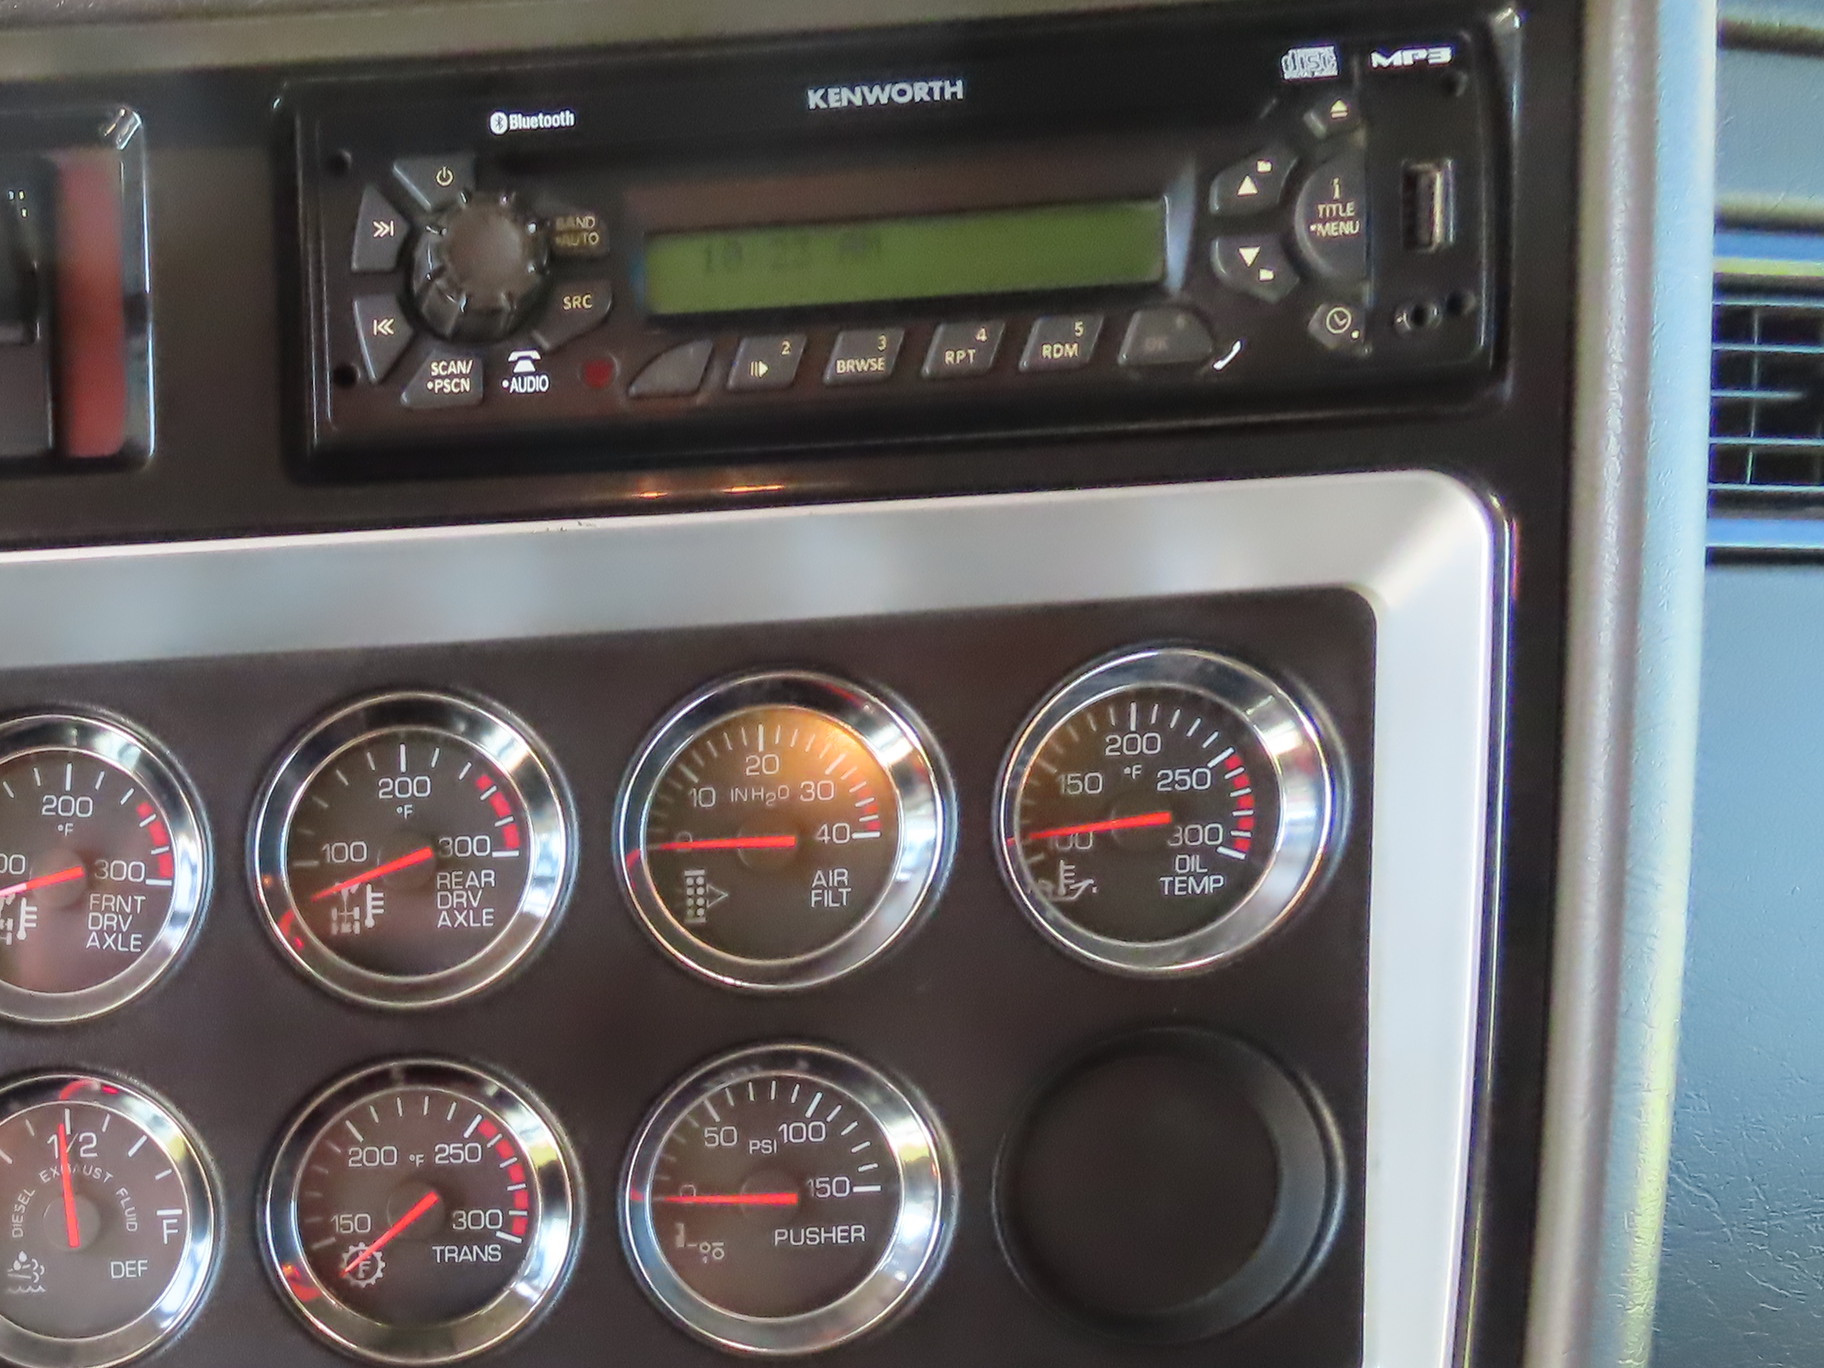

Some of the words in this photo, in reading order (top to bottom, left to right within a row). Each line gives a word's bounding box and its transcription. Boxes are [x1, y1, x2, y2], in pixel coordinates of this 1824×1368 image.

[1371, 46, 1453, 69] MP3
[807, 78, 964, 111] KENWORTH
[509, 109, 576, 132] Bluetooth
[1317, 202, 1355, 218] TITLE
[563, 294, 592, 310] SRC
[976, 327, 988, 343] 4
[1074, 321, 1084, 337] 5
[780, 340, 792, 356] 2
[877, 335, 887, 351] 3
[1041, 341, 1079, 360] RDM
[836, 355, 885, 374] BRWSE
[945, 348, 977, 366] RPT
[431, 360, 473, 376] SCAN/
[509, 375, 550, 393] AUDIO
[1105, 733, 1161, 756] 200
[745, 754, 780, 776] 20
[378, 776, 431, 799] 200
[1059, 772, 1103, 794] 150
[1156, 767, 1211, 792] 250
[690, 787, 716, 808] 10
[800, 780, 834, 801] 30
[41, 795, 93, 817] 200
[815, 823, 851, 844] 40
[1167, 823, 1223, 846] 300
[322, 841, 368, 863] 100
[438, 835, 491, 858] 300
[93, 860, 145, 882] 300
[1175, 854, 1209, 873] OIL
[437, 870, 495, 890] REAR
[811, 869, 849, 887] AIR
[1159, 876, 1225, 895] TEMP
[89, 894, 146, 914] FRNT
[437, 891, 482, 909] DRV
[811, 888, 851, 907] FILT
[87, 912, 133, 932] DRV
[437, 908, 495, 928] AXLE
[85, 932, 142, 952] AXLE
[704, 1126, 738, 1147] 50
[749, 1140, 778, 1154] PSI
[778, 1121, 826, 1143] 100
[348, 1146, 398, 1168] 200
[434, 1143, 482, 1164] 250
[805, 1177, 851, 1198] 150
[12, 1189, 35, 1238] DIESEL
[116, 1187, 138, 1232] FLUID
[452, 1209, 503, 1230] 300
[162, 1219, 178, 1244] F
[330, 1213, 371, 1234] 150
[775, 1225, 866, 1246] PUSHER
[432, 1245, 502, 1263] TRANS
[110, 1260, 148, 1279] DEF
